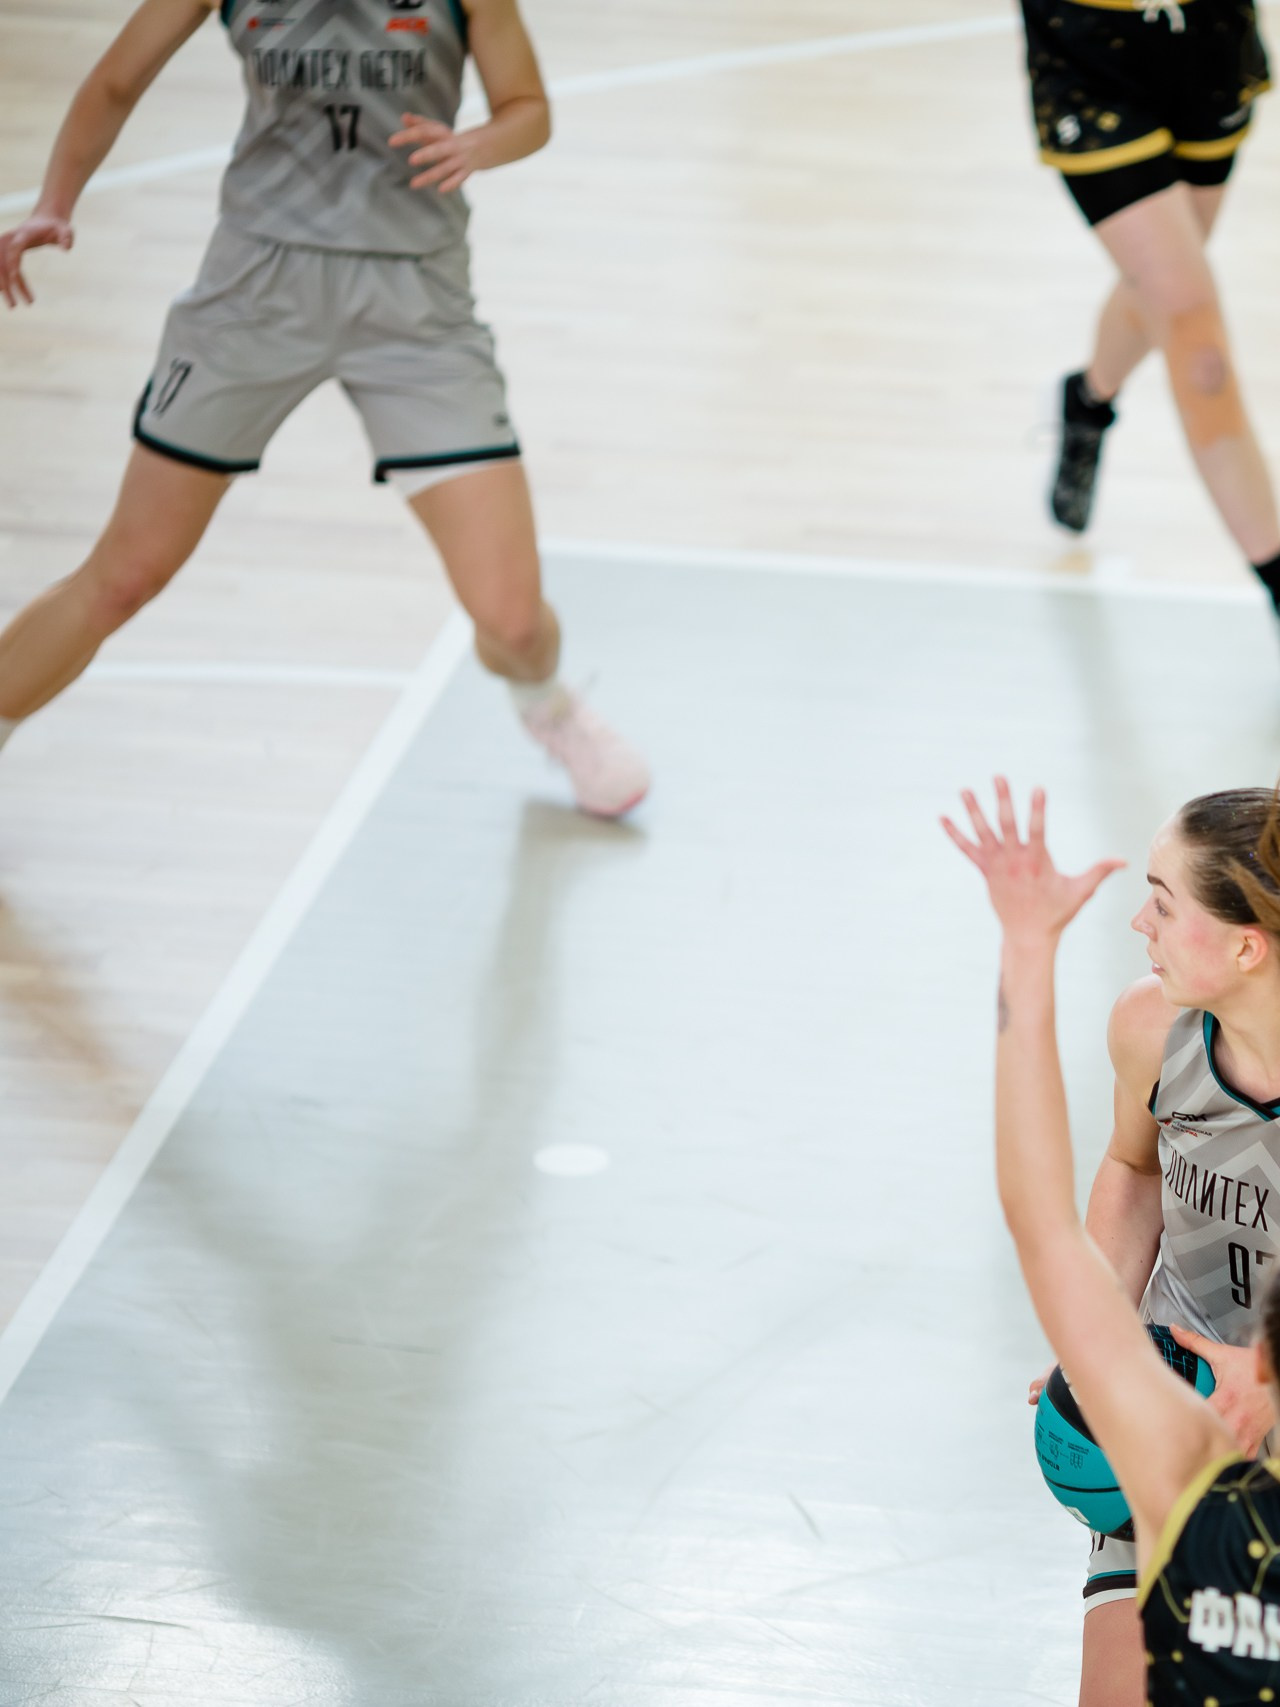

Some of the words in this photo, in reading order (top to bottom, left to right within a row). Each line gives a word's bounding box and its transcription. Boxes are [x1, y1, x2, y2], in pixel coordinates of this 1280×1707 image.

[323, 105, 361, 151] 17
[153, 358, 193, 417] 17
[1165, 1149, 1270, 1232] ПОЛИТЕХ
[1228, 1242, 1277, 1310] 9
